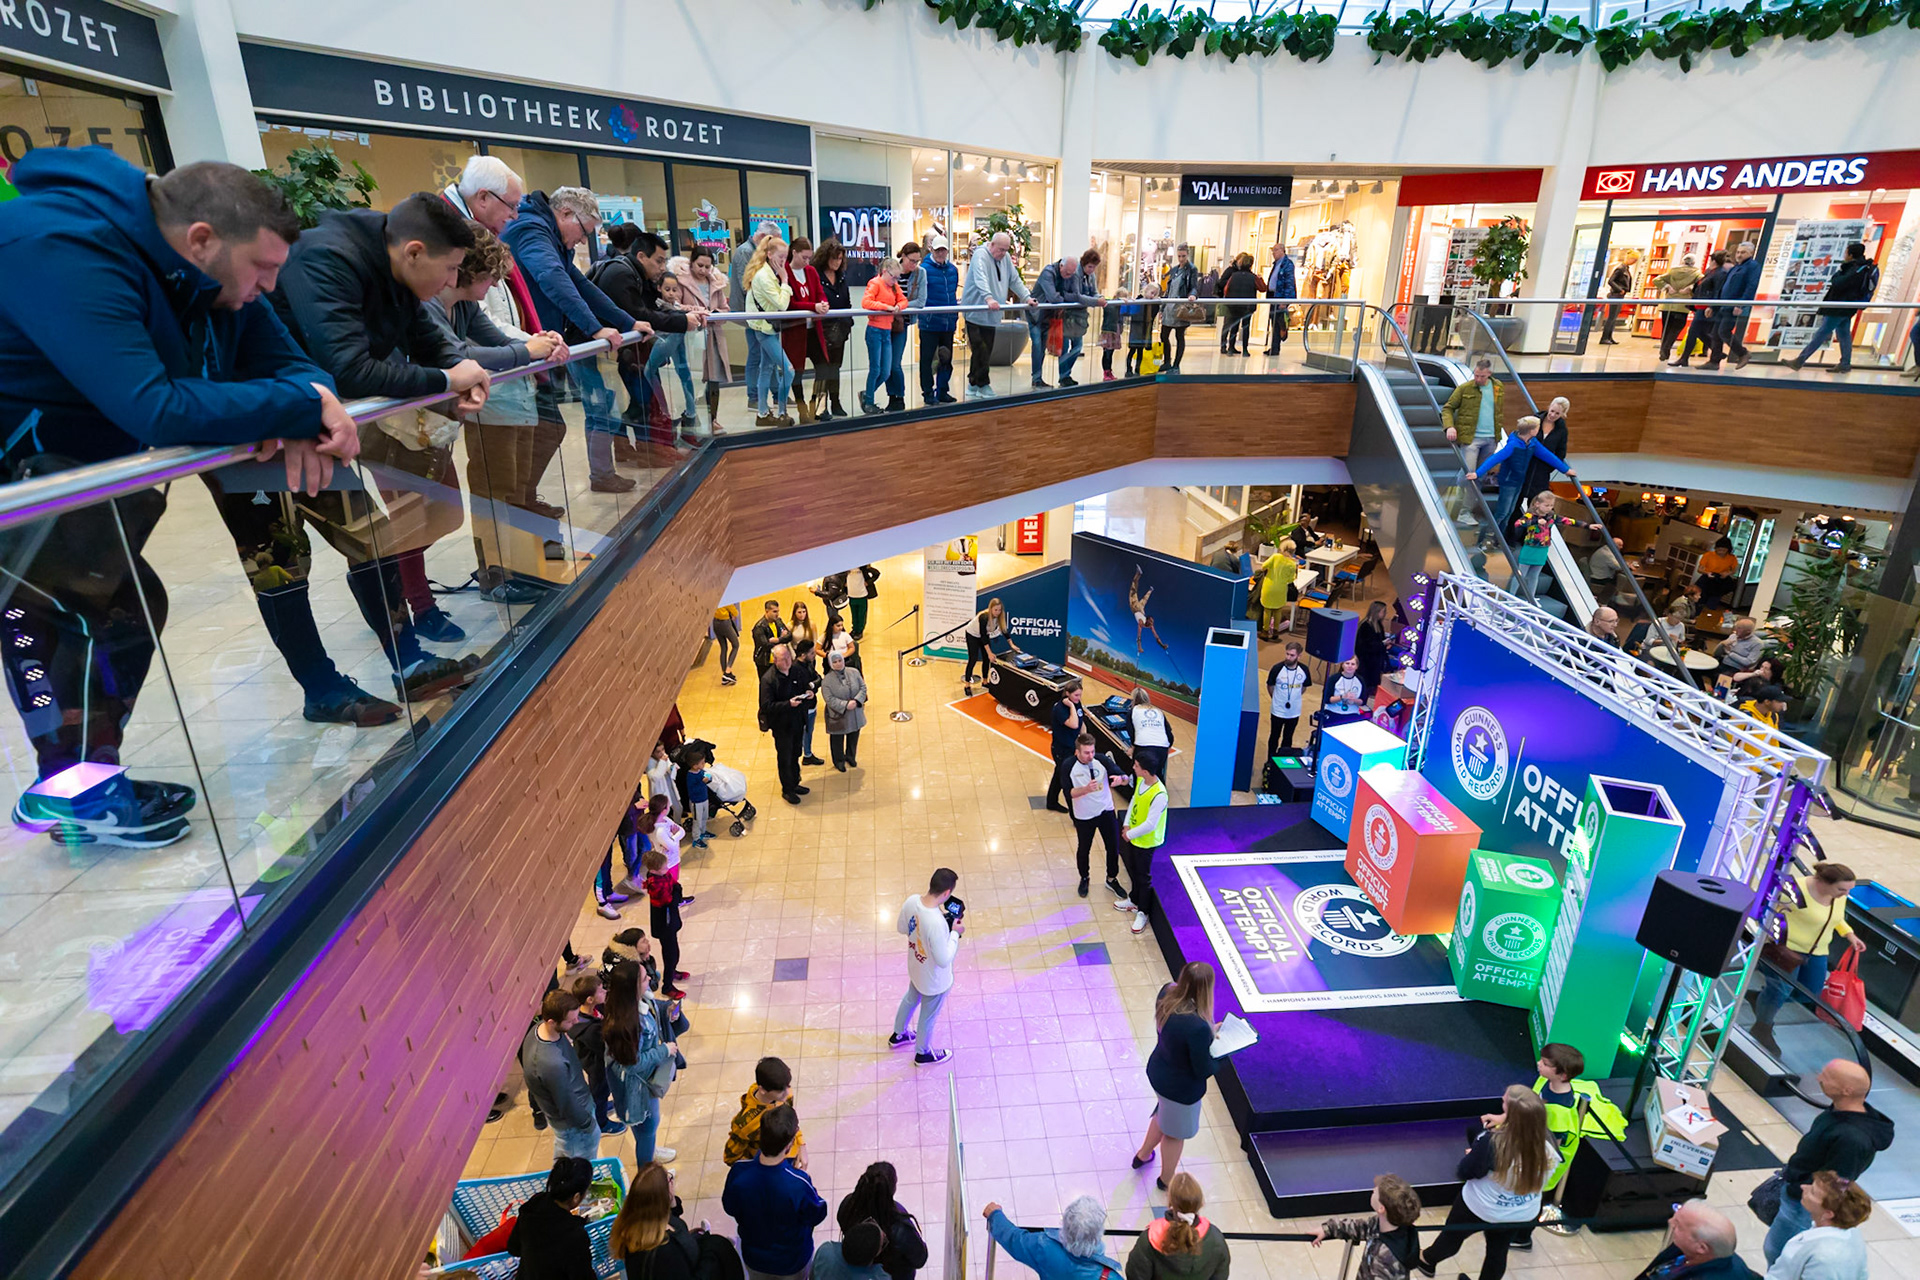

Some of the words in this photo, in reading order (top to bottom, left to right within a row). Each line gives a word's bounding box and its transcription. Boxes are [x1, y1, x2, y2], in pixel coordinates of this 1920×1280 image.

[0, 0, 118, 57] ROZET
[373, 79, 601, 132] BIBLIOTHEEK
[645, 116, 724, 146] ROZET
[1641, 164, 1728, 193] HANS
[1730, 157, 1869, 190] ANDERS
[1226, 186, 1283, 195] MANNENMODE
[1010, 616, 1062, 629] OFFICIAL
[1010, 626, 1062, 638] ATTEMPT
[1464, 712, 1504, 751] GUINNESS
[1455, 732, 1467, 779] WORLD
[1467, 764, 1504, 795] RECORDS
[1315, 800, 1347, 824] ATTEMPT
[1316, 792, 1348, 818] OFFICIAL
[1416, 795, 1458, 832] OFFICIAL
[1355, 869, 1388, 911] ATTEMPT
[1357, 858, 1389, 902] OFFICIAL
[1301, 889, 1344, 913] WORLD
[1218, 888, 1279, 963] ATTEMPT
[1241, 886, 1299, 962] OFFICIAL
[1305, 915, 1384, 952] RECORDS
[1495, 916, 1540, 933] GUINNESS
[1487, 930, 1503, 954] WORLD
[1506, 938, 1543, 959] RECORDS
[1472, 972, 1536, 990] ATTEMPT
[1474, 963, 1537, 982] OFFICIAL
[1338, 993, 1383, 1001] CHAMPIONS
[1670, 1139, 1714, 1158] INLEVERBOX
